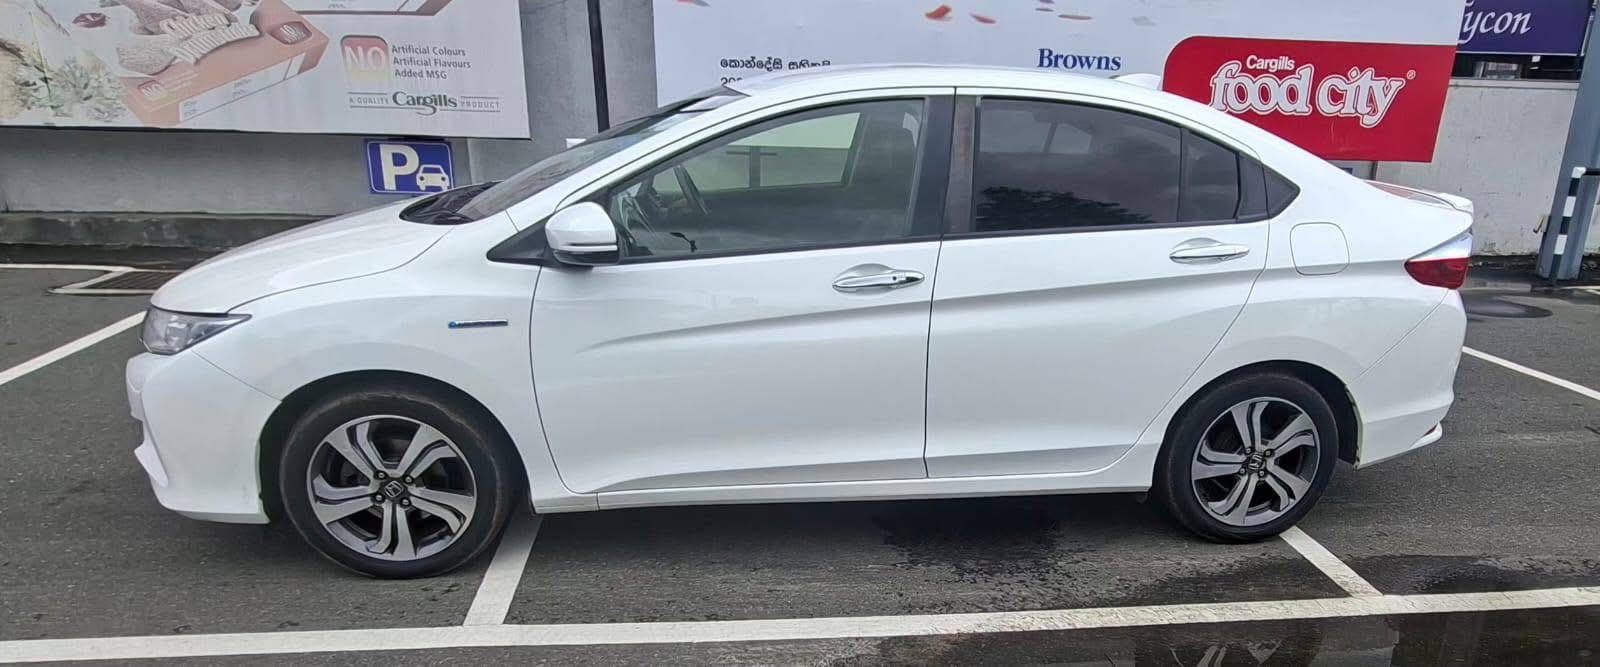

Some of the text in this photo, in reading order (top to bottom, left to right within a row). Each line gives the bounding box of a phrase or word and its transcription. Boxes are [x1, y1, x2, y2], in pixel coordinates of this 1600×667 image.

[1458, 0, 1531, 44] ycon
[344, 46, 387, 72] NO
[392, 45, 466, 57] Artificial Colours
[1037, 48, 1122, 71] Browns
[393, 57, 471, 69] Artificial Flavours
[395, 69, 447, 79] Added MSG
[1246, 55, 1295, 71] Cargills
[392, 91, 457, 115] Cargills
[1209, 60, 1405, 128] food city
[380, 143, 420, 190] P
